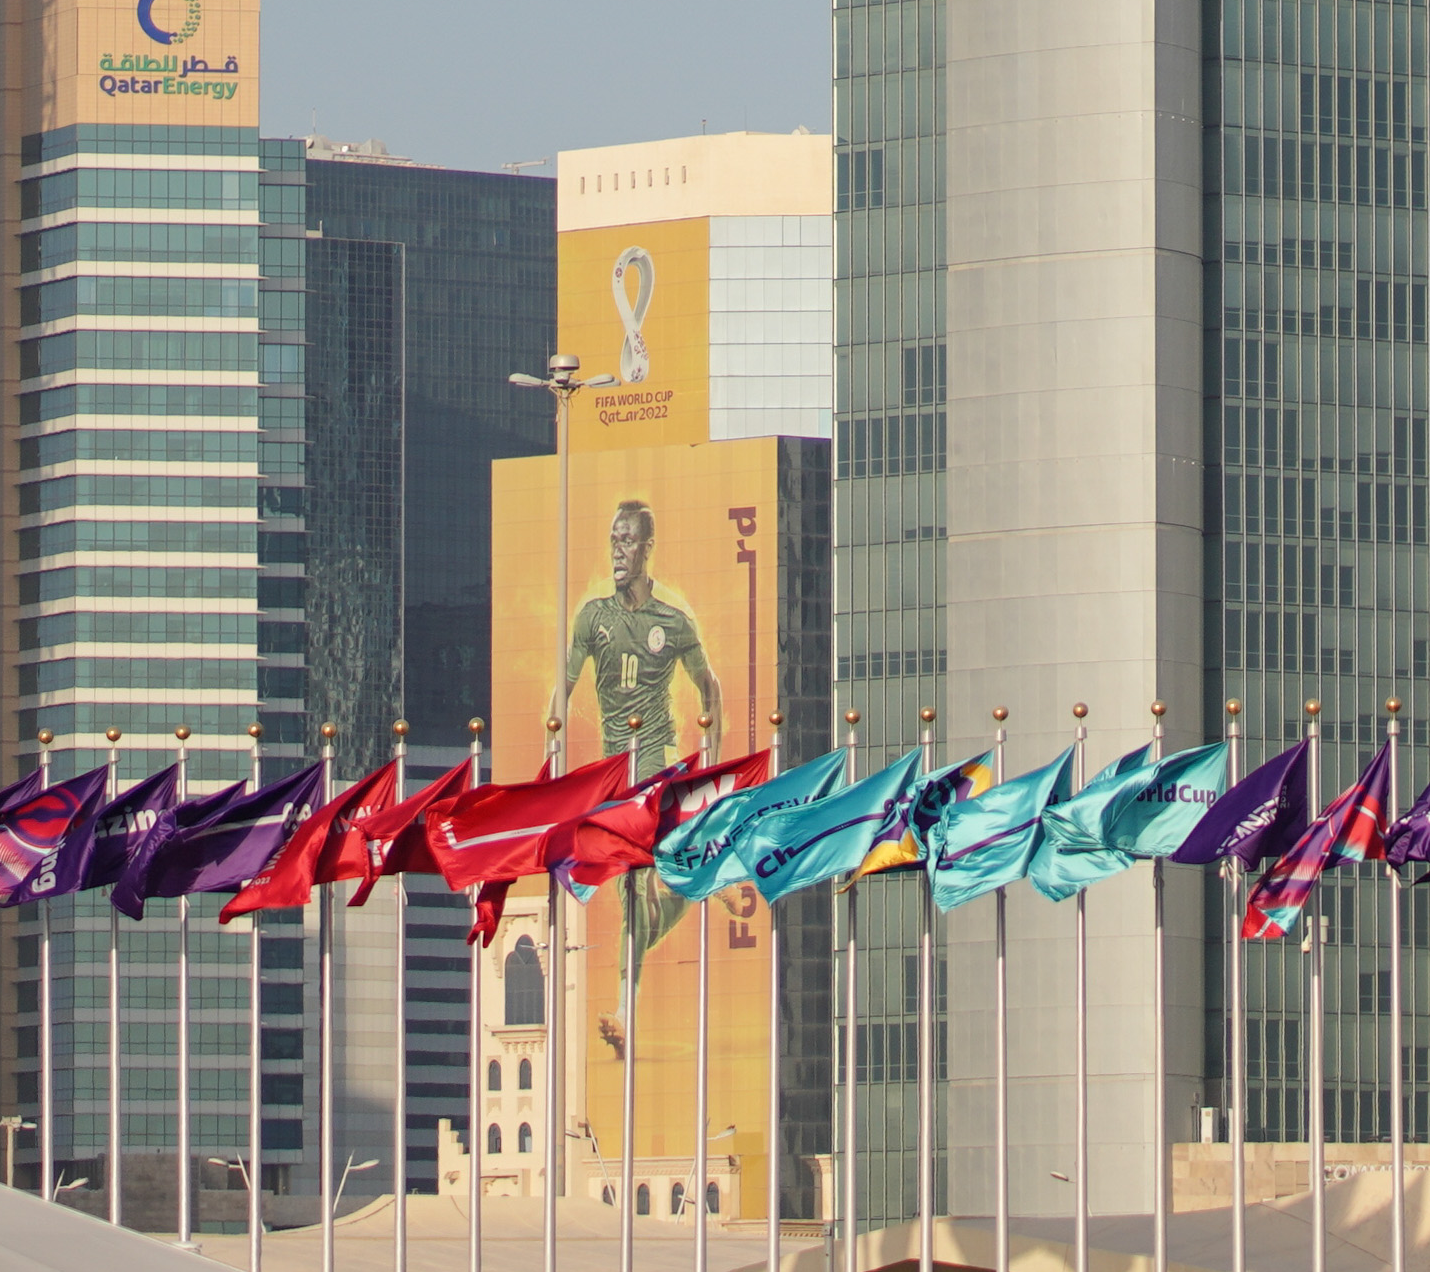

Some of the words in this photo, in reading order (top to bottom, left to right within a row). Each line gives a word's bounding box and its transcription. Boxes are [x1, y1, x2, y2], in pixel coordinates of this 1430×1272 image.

[99, 53, 178, 72] للطاقة
[178, 56, 239, 78] قطر
[99, 75, 239, 100] QatarEnergy
[595, 396, 616, 409] FIFA
[617, 392, 653, 407] WORLD
[654, 390, 673, 403] CUP
[620, 652, 639, 690] 10
